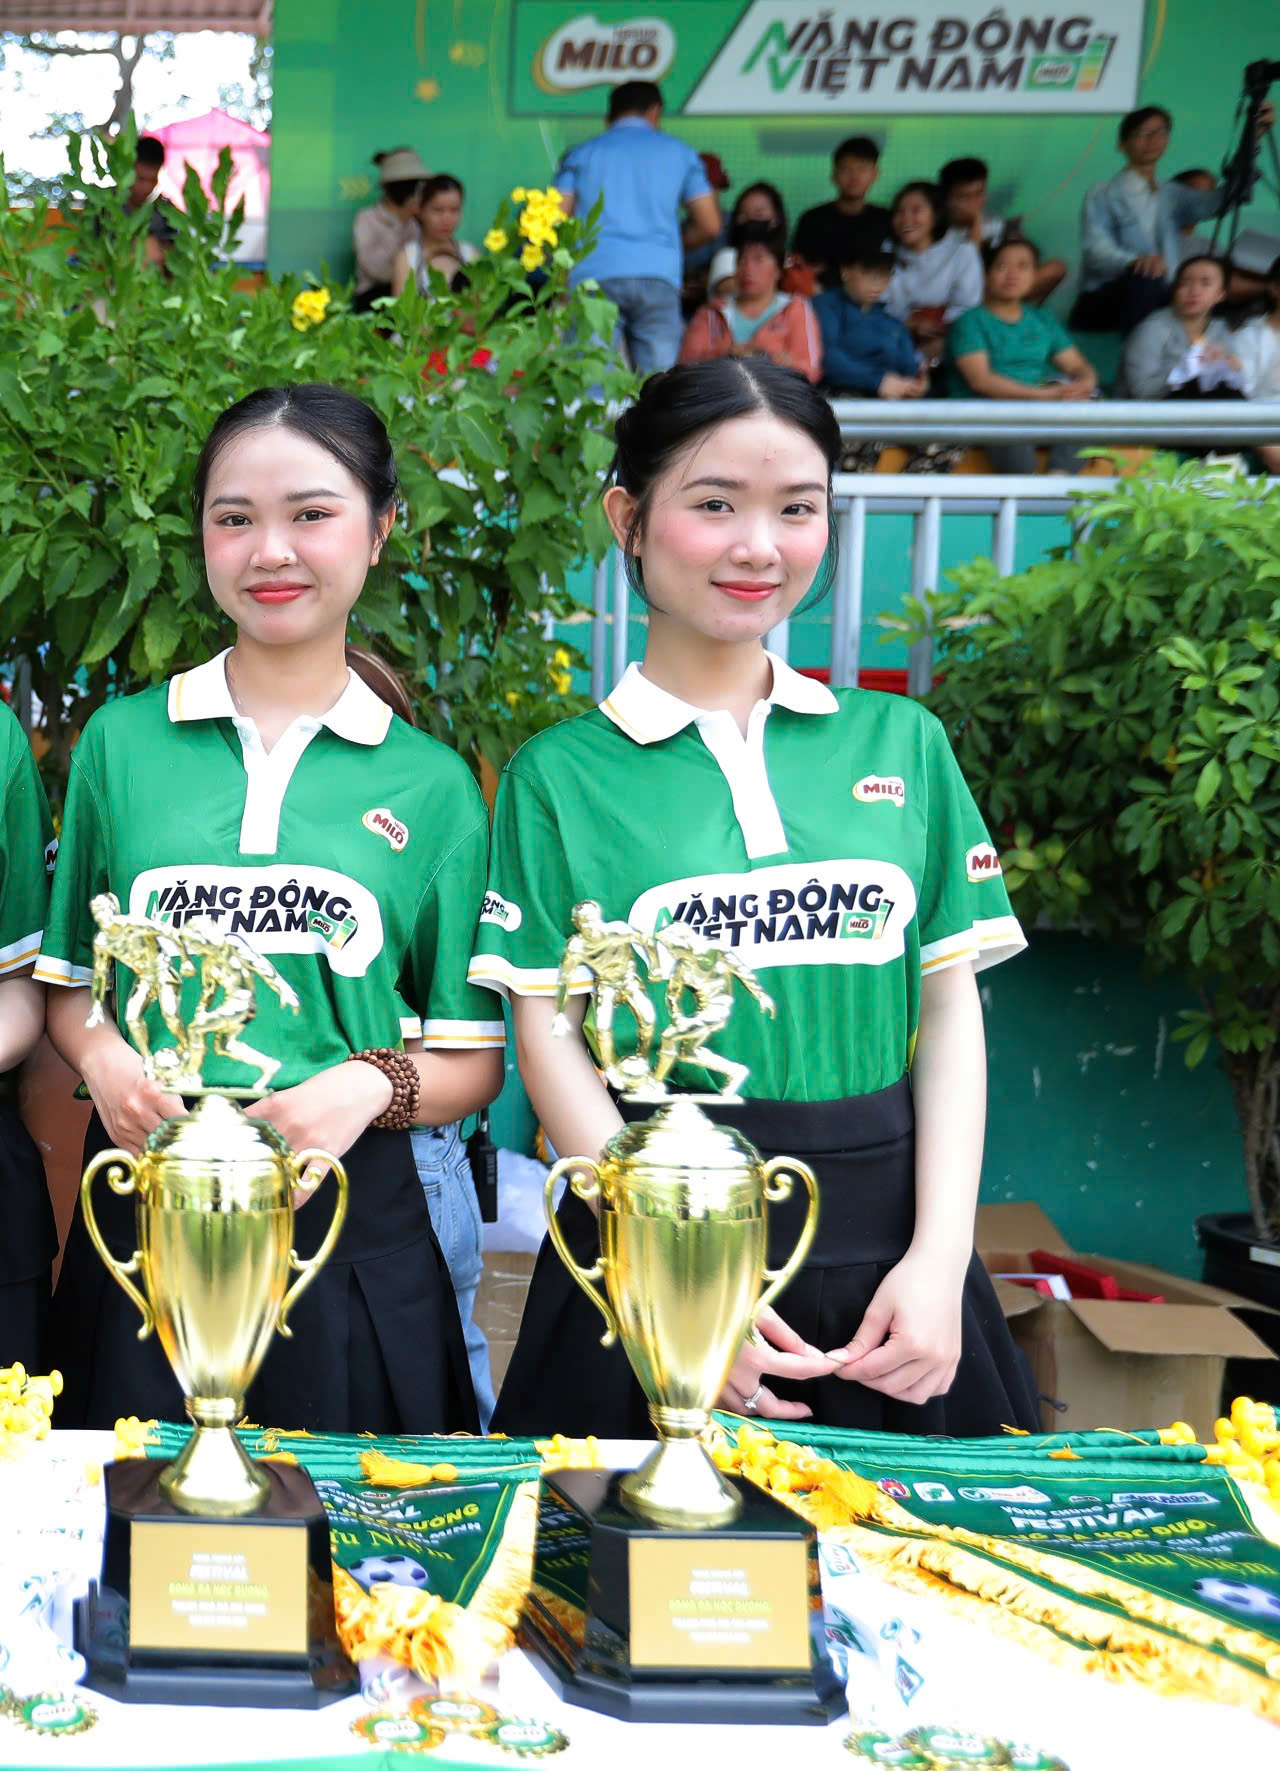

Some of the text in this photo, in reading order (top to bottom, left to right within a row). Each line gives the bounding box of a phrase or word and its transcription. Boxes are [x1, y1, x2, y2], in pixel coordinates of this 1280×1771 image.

[557, 40, 659, 72] MILO
[766, 50, 1027, 99] VIỆT NAM
[863, 783, 904, 797] MILO
[372, 813, 404, 845] MILO
[145, 879, 243, 919] NĂNG
[230, 908, 309, 933] NAM
[312, 918, 331, 933] MILO
[654, 892, 759, 938] NĂNG
[753, 912, 840, 944] NAM
[849, 919, 869, 929] MILO
[429, 1522, 482, 1539] MINH
[1010, 1507, 1166, 1531] FESTIVAL
